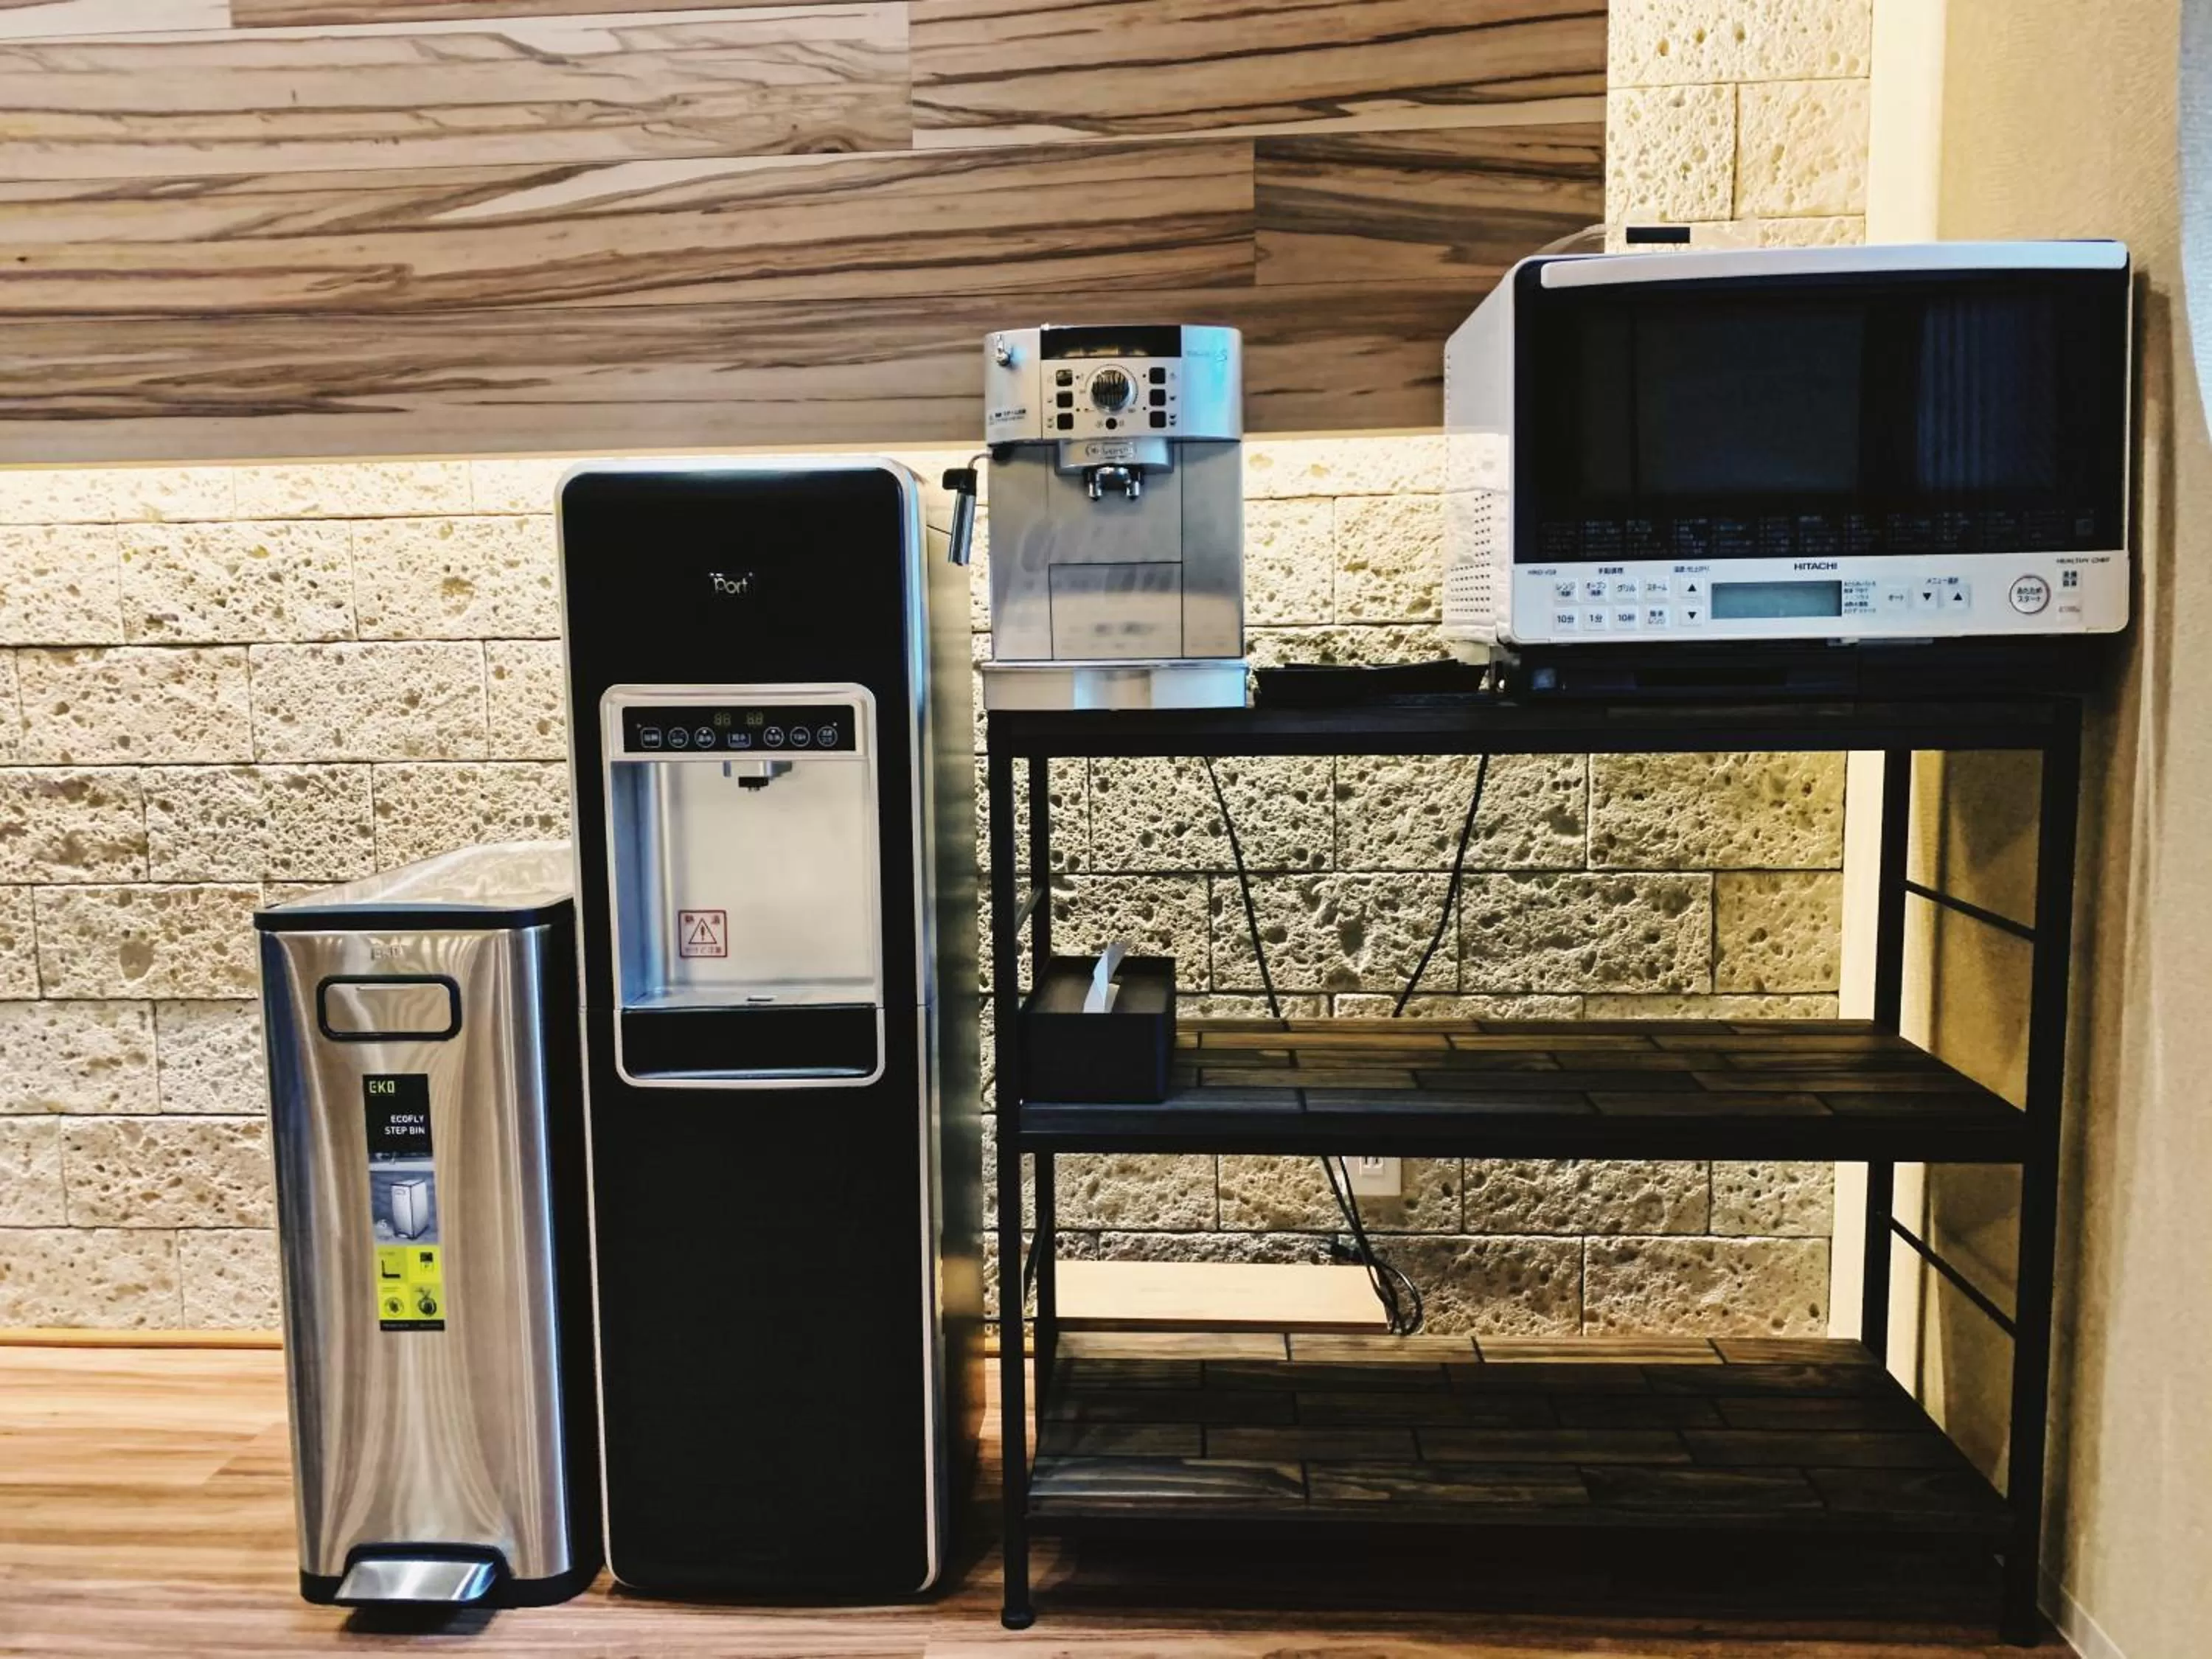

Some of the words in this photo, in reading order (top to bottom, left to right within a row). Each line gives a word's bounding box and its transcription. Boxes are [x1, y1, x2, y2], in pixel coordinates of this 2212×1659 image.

[1794, 562, 1838, 570] HITACHI
[1557, 614, 1574, 623] 10分
[1589, 613, 1604, 623] 1分
[369, 1080, 395, 1093] EKO
[390, 1114, 425, 1123] ECOFLY
[384, 1126, 408, 1135] STEP
[409, 1126, 425, 1135] BIN
